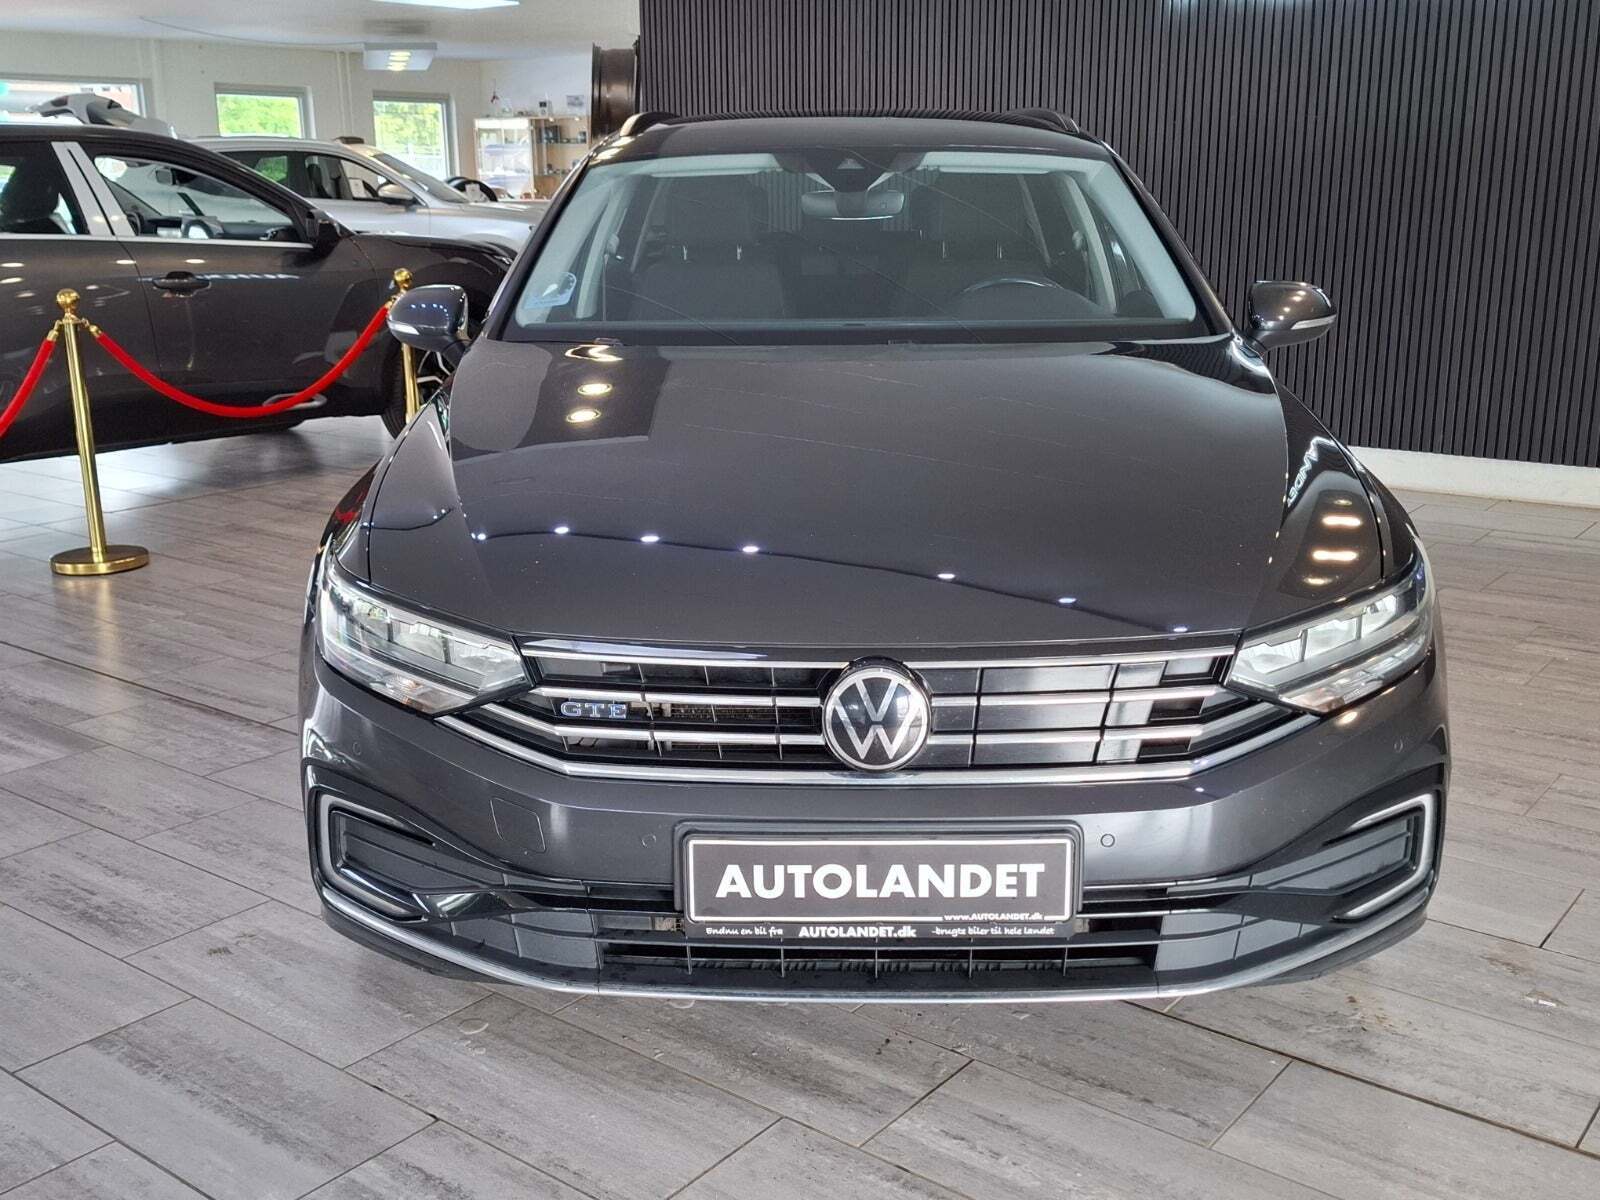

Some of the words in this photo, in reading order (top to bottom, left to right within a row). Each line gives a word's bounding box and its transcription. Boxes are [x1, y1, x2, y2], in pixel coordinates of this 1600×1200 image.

[561, 702, 627, 719] GTE
[715, 863, 1045, 898] AUTOLANDET
[943, 912, 1043, 921] www.AUTOLANDET.dk
[740, 928, 753, 936] en
[754, 926, 767, 936] bil
[768, 926, 784, 937] fra
[798, 926, 917, 938] AUTOLANDET.dk
[968, 926, 990, 935] biler
[990, 926, 1002, 935] til
[1004, 926, 1021, 935] hele
[1023, 926, 1056, 935] landet
